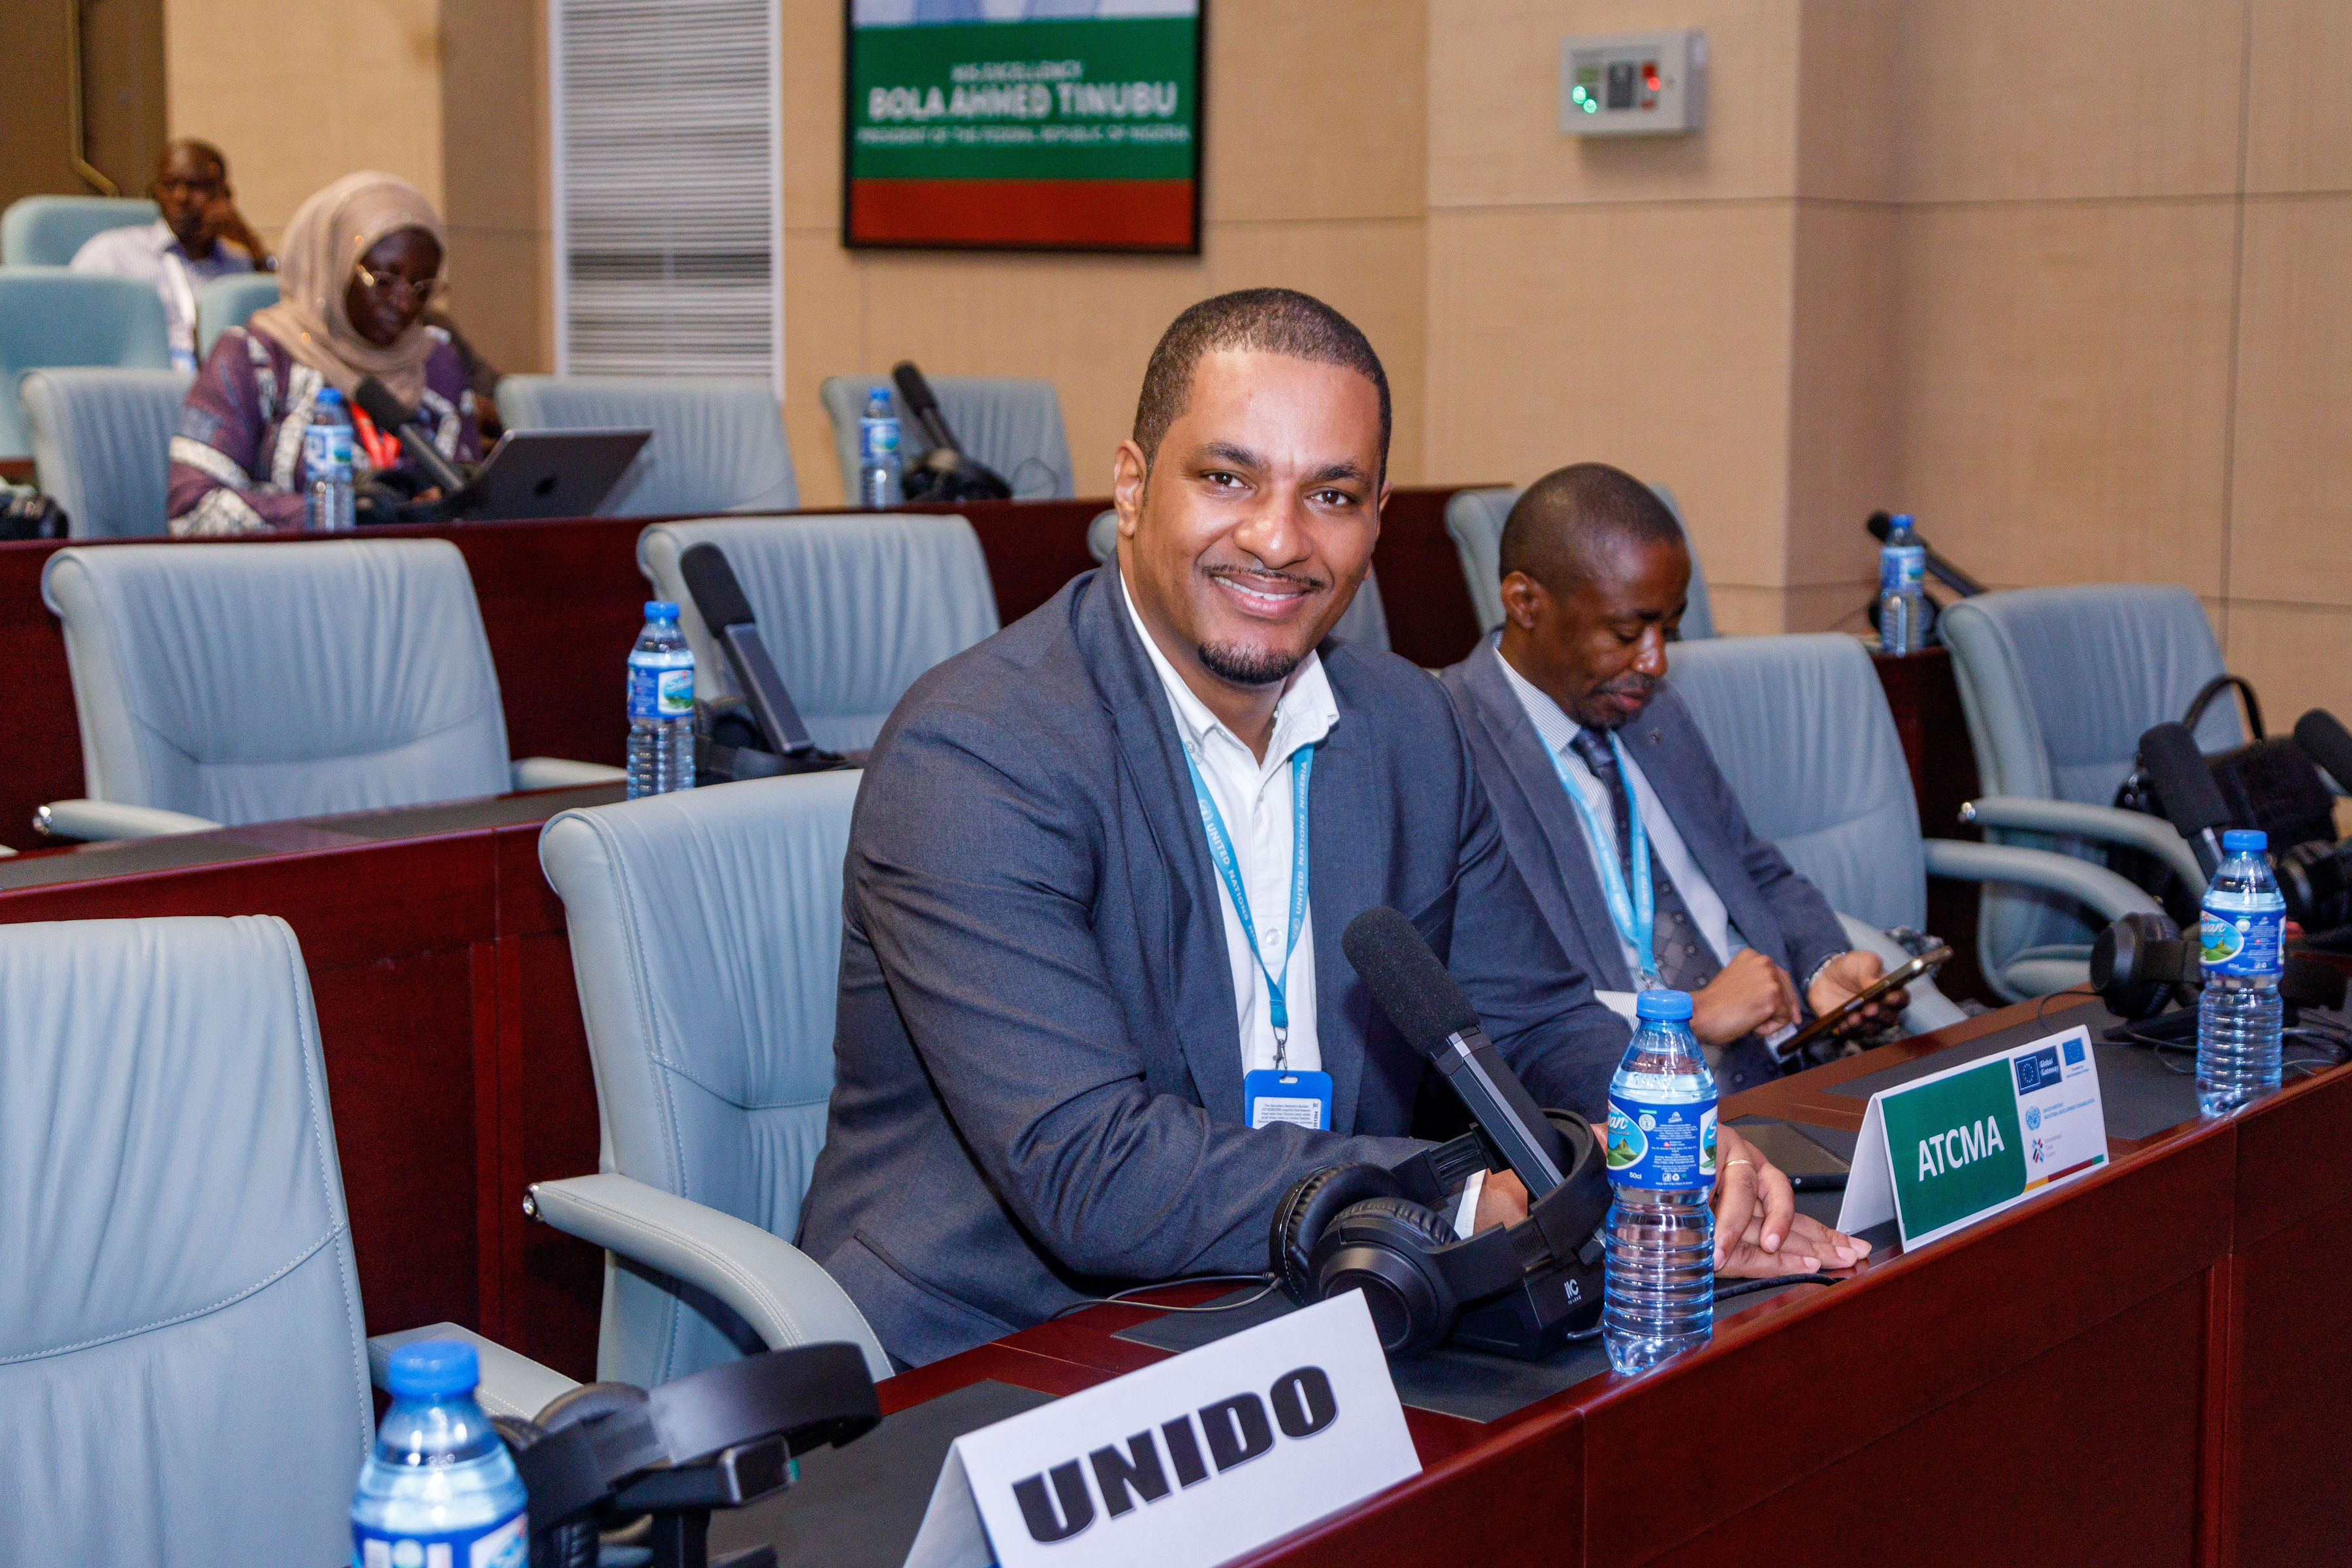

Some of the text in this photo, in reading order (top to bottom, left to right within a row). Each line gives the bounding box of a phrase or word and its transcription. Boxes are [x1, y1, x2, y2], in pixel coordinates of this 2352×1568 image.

[868, 82, 1177, 122] BOLA AHMED TINUBU
[1299, 762, 1307, 809] NIGERIA
[1206, 822, 1249, 921] UNITED NATIONS
[1296, 871, 1305, 915] UNITED
[2201, 922, 2226, 933] wan
[2040, 1057, 2053, 1068] Global
[2041, 1065, 2060, 1076] Gateway
[1608, 1115, 1627, 1130] an
[1918, 1115, 2005, 1182] ATCMA
[1011, 1365, 1340, 1544] UNIDO
